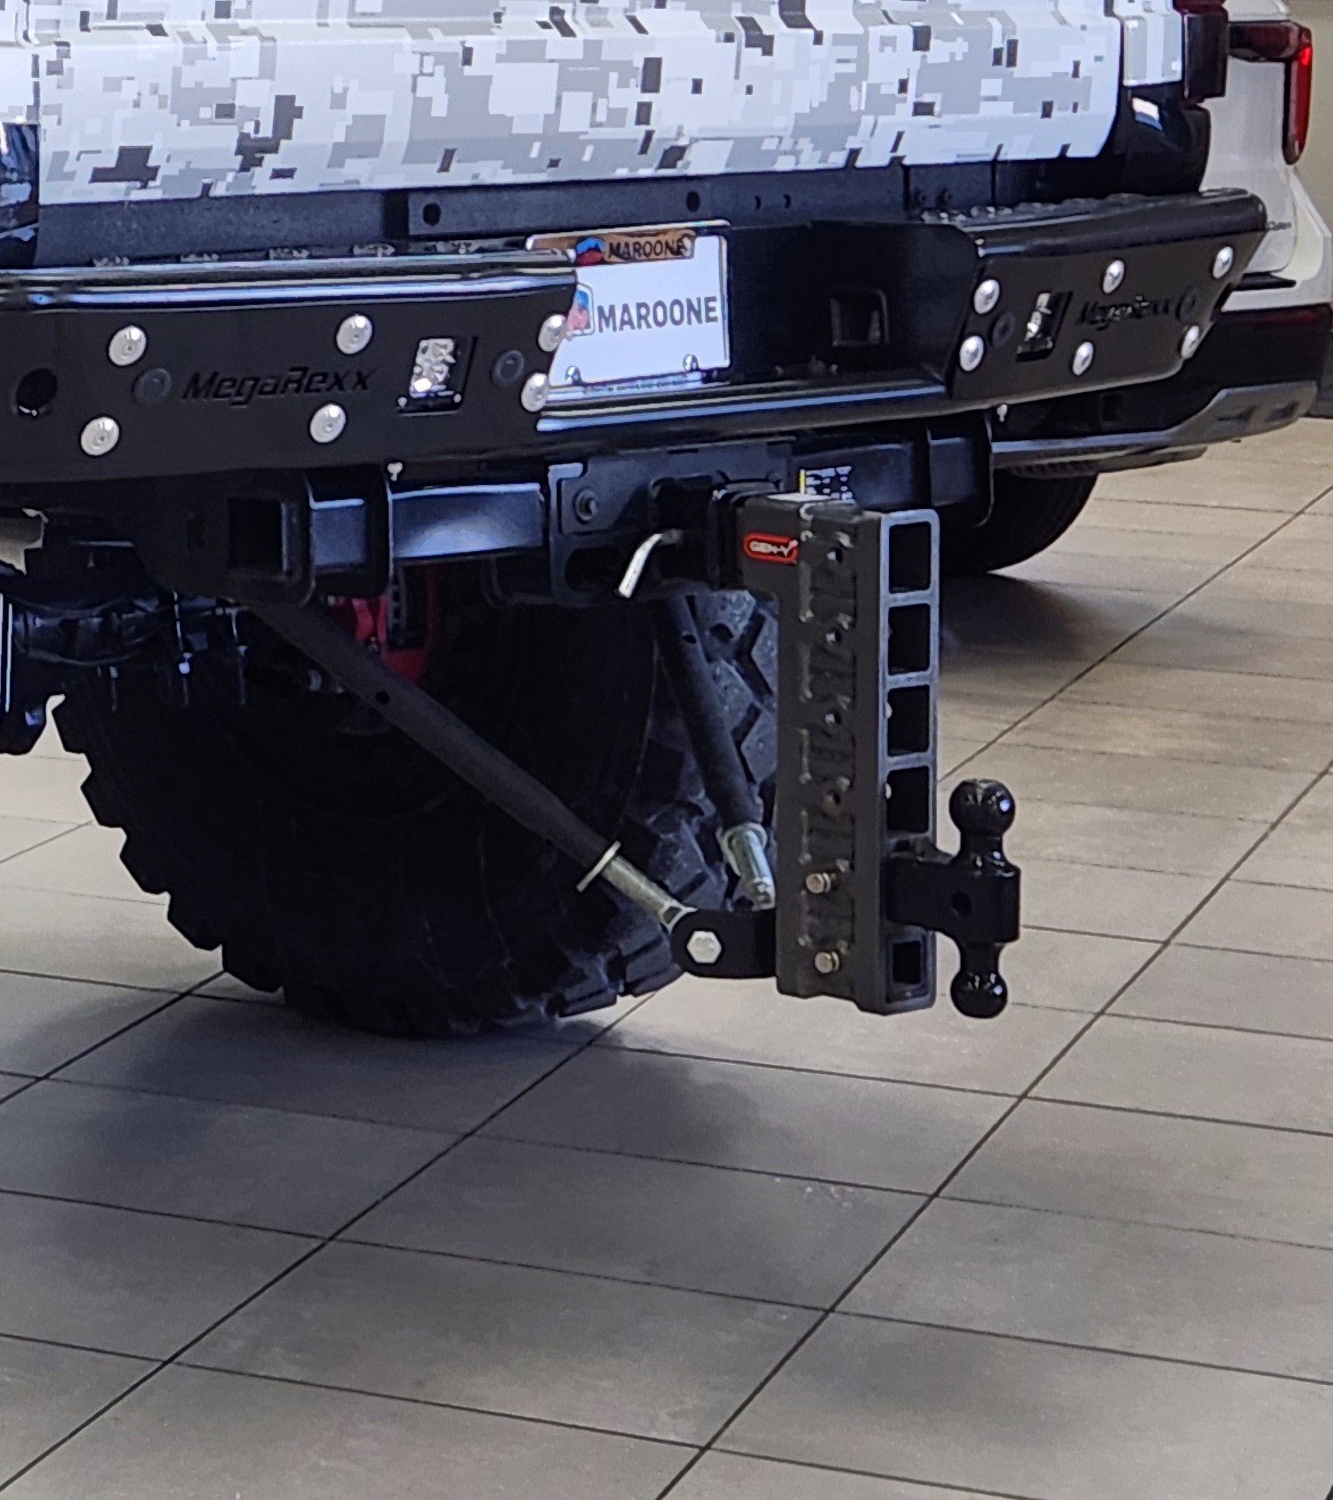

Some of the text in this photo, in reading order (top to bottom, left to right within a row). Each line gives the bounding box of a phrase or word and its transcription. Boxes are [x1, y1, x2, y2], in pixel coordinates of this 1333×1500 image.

[607, 238, 689, 261] MAROONE
[597, 296, 719, 333] MAROONE
[182, 366, 377, 407] MegaRexx
